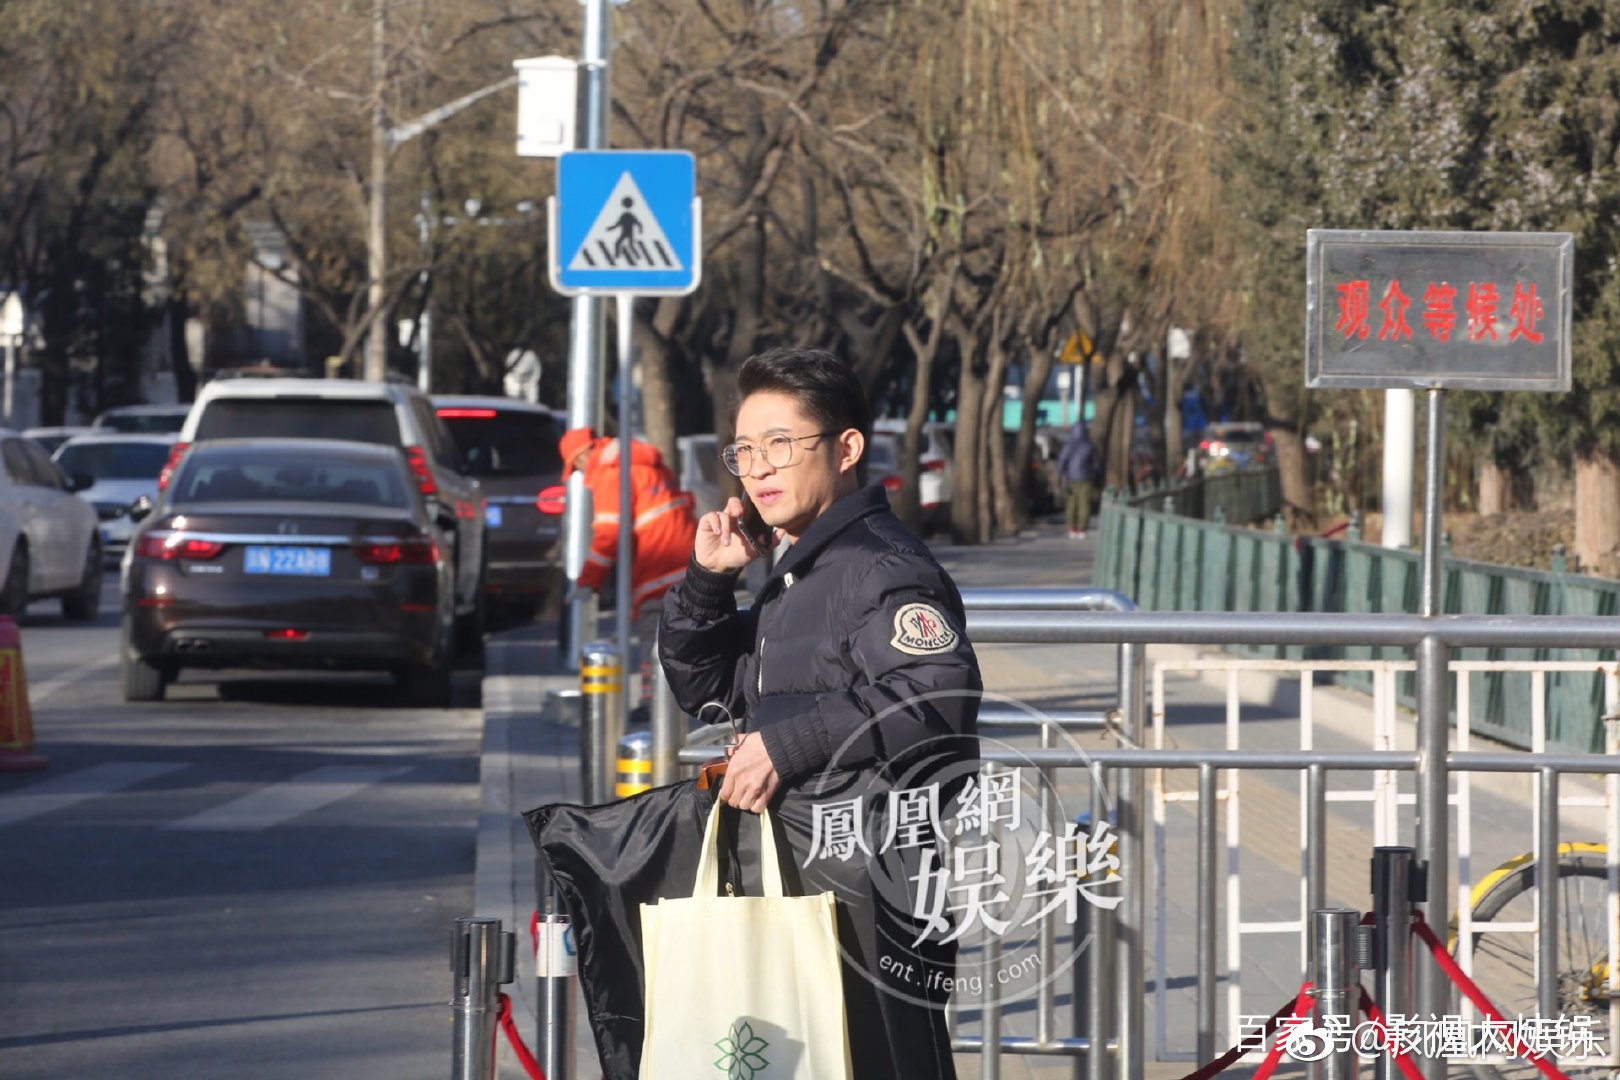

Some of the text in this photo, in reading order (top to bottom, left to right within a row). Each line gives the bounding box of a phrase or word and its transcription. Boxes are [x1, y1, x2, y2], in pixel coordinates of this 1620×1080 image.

[1335, 279, 1544, 343] 观众等候处
